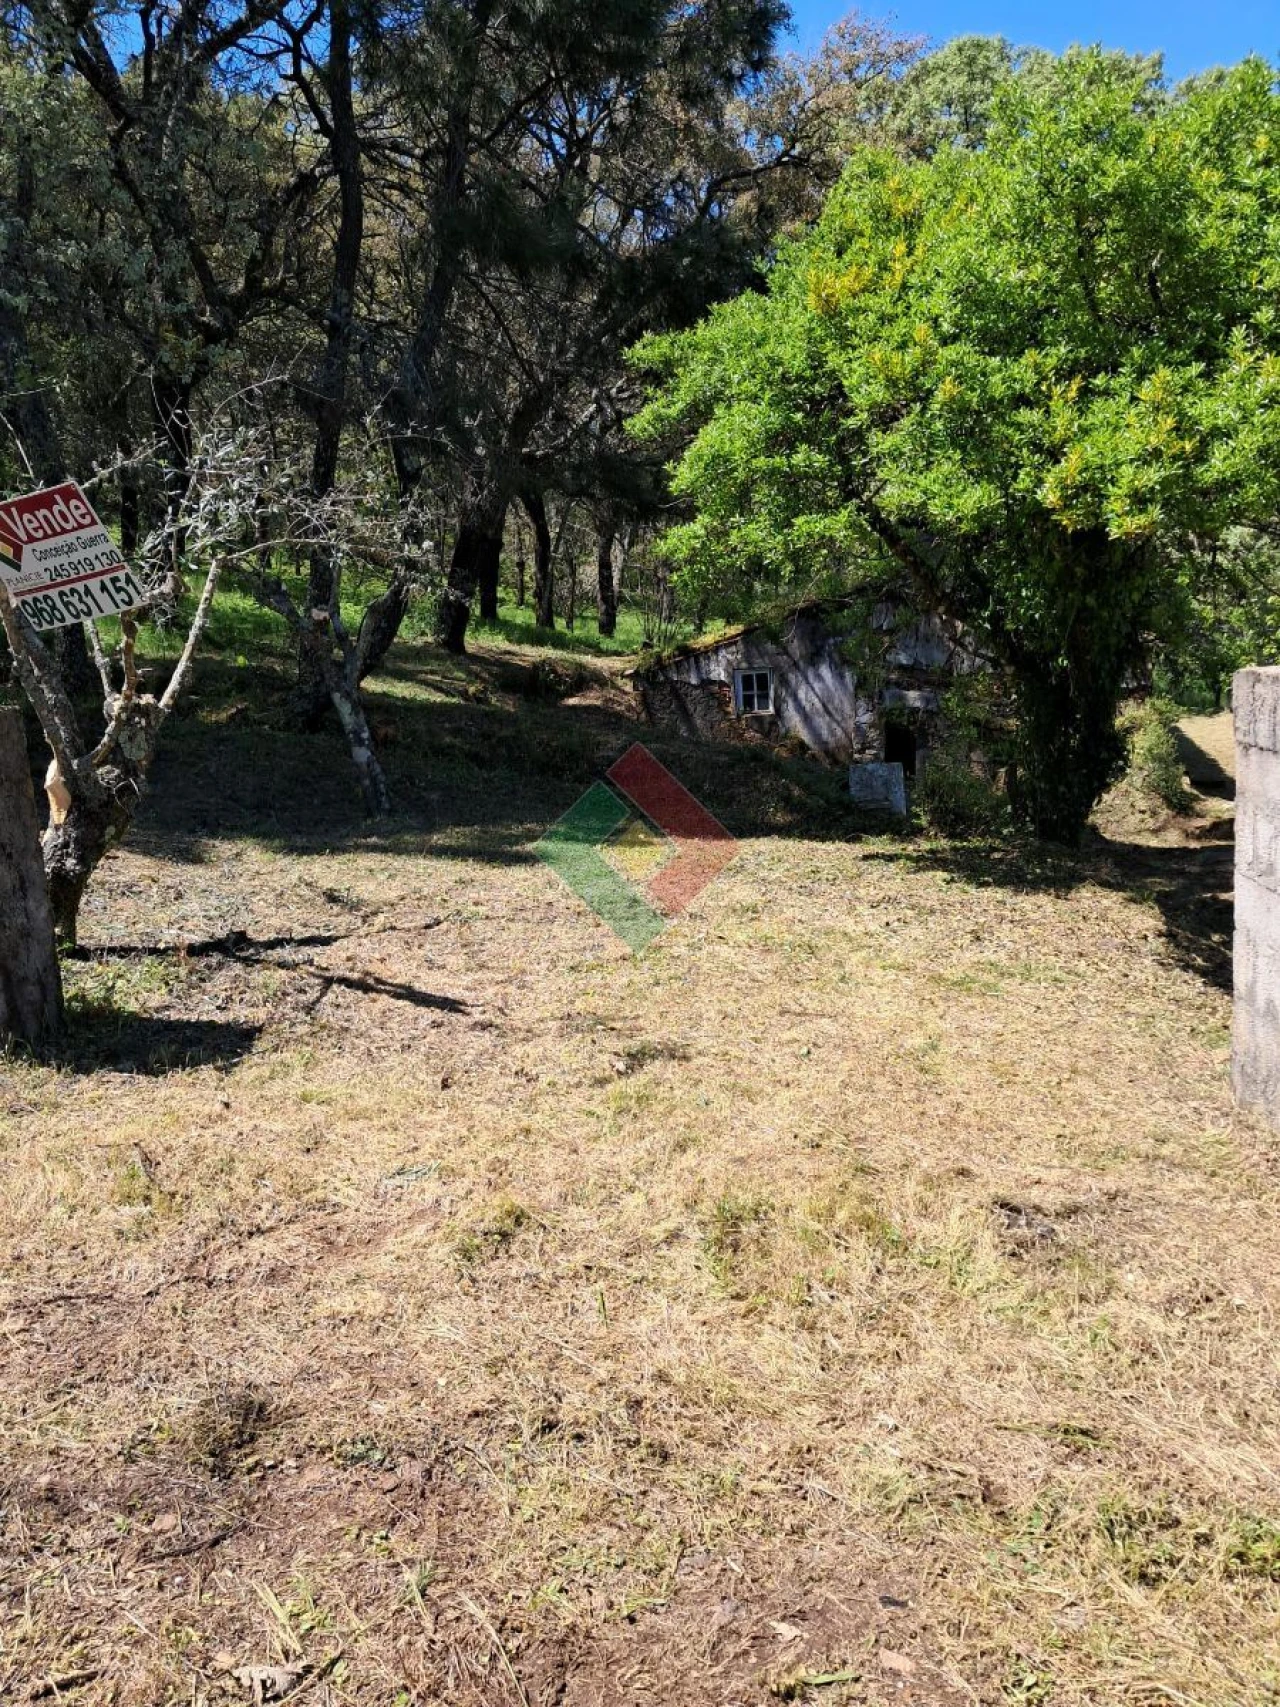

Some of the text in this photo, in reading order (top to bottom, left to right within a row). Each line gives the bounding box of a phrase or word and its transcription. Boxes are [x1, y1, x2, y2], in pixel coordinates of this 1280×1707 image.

[0, 494, 92, 542] Vende
[31, 533, 109, 562] Conceição Guerra
[44, 549, 120, 582] 245 919 130
[20, 571, 142, 628] 968 631 151
